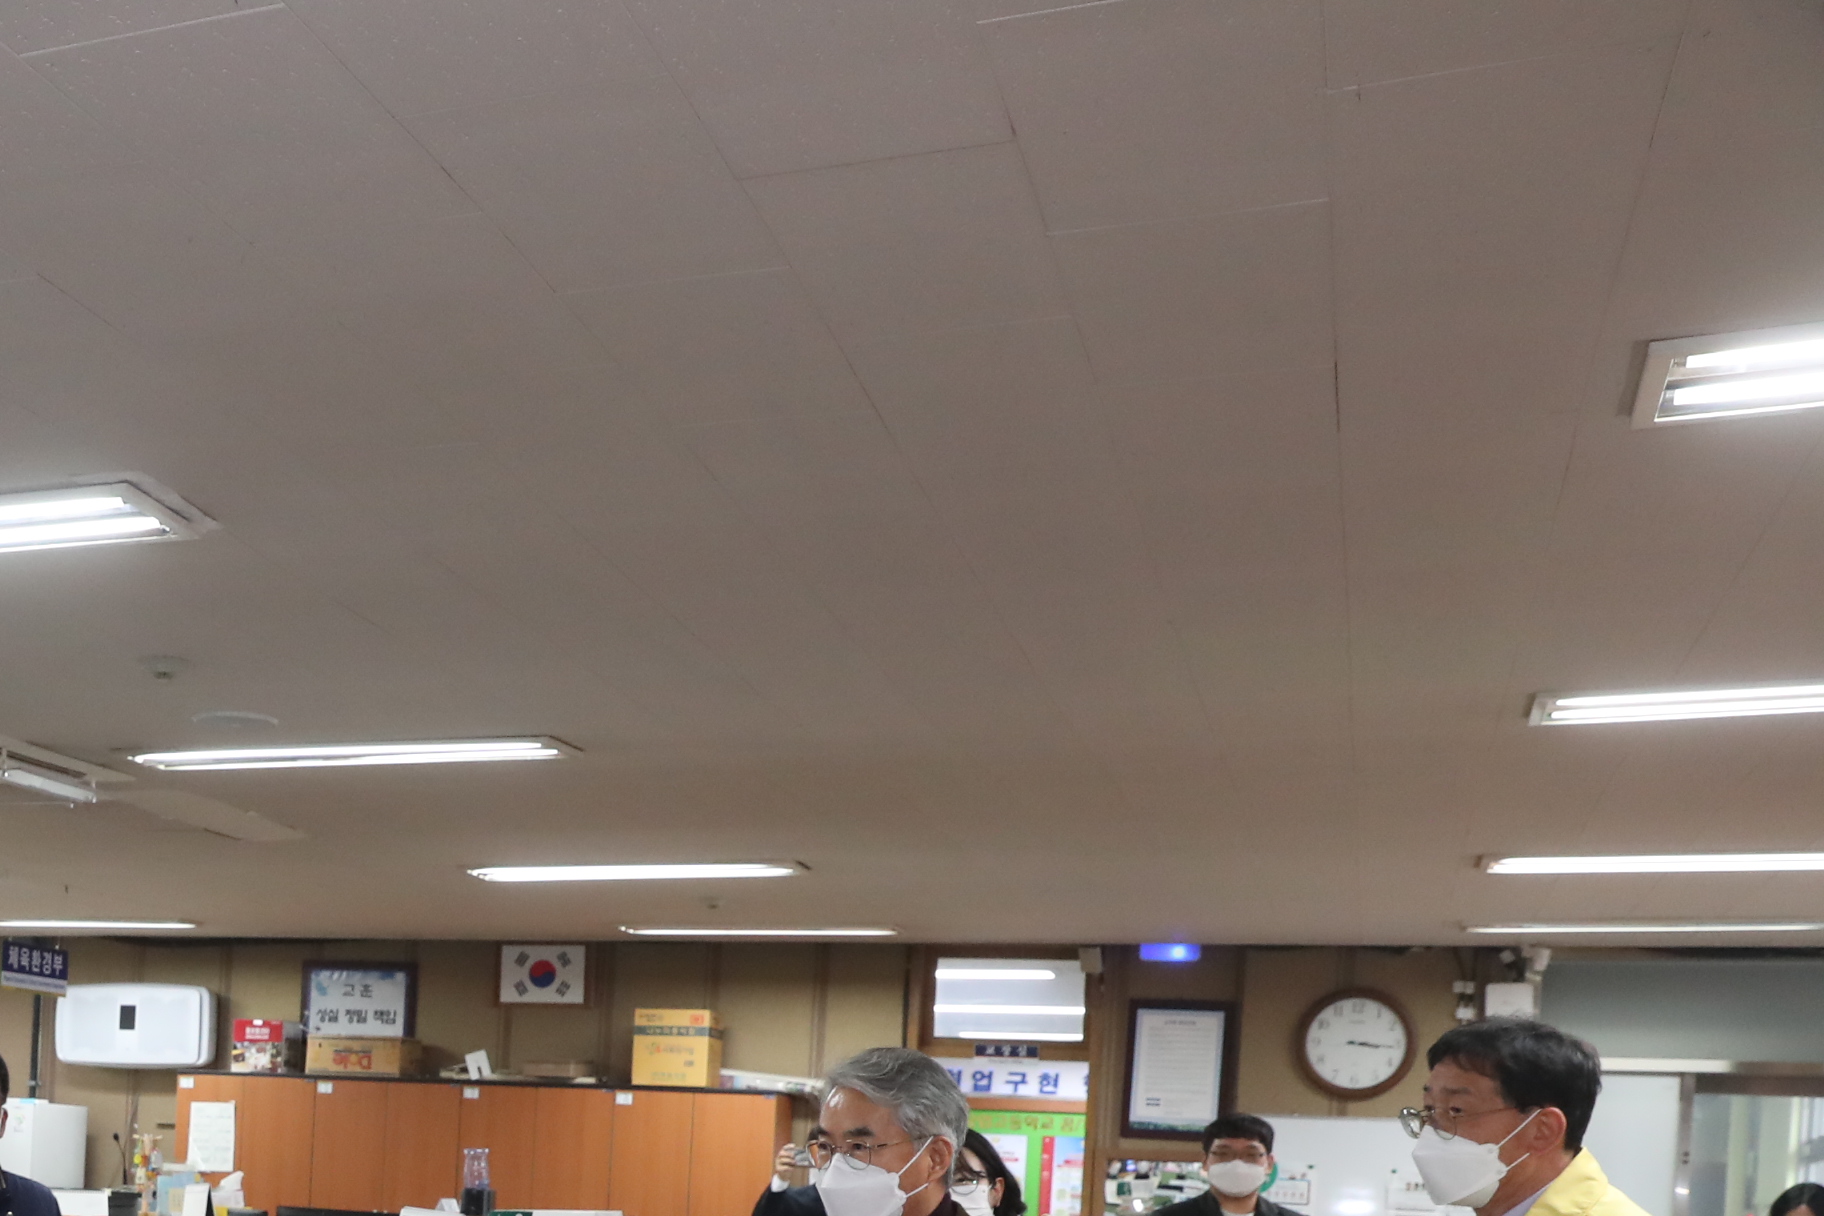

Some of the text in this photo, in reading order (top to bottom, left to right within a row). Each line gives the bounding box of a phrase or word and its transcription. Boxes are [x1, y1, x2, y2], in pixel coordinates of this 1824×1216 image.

[8, 945, 63, 976] 체육환경부
[316, 1007, 397, 1025] 성실 정밀 책임
